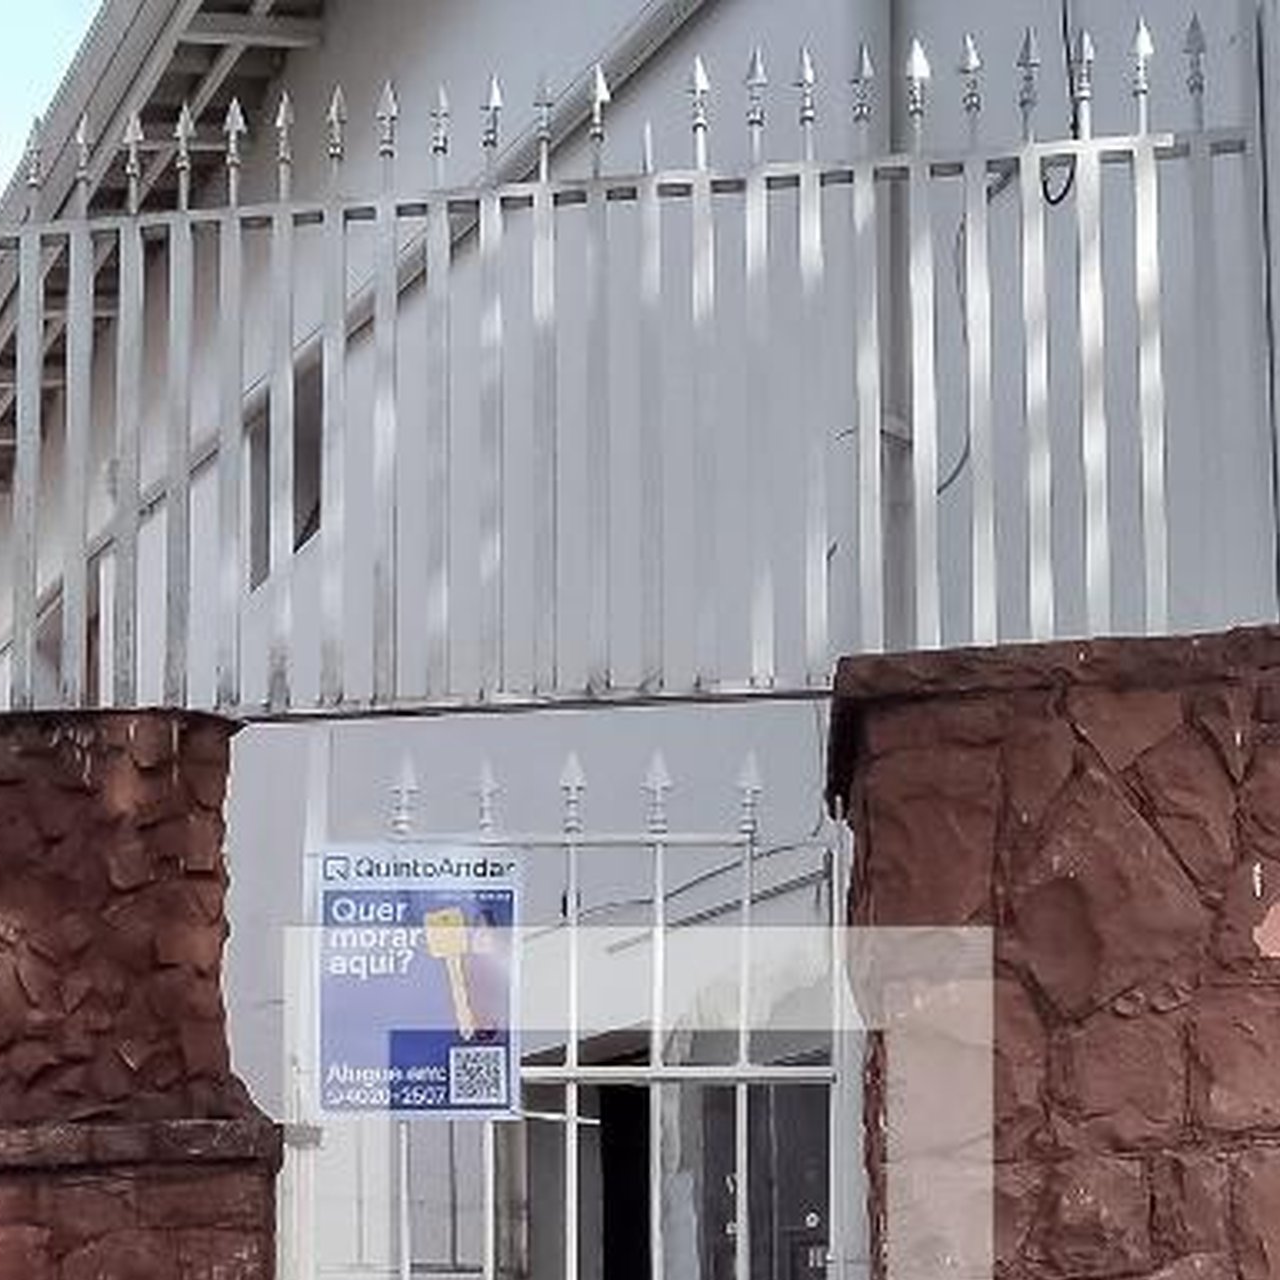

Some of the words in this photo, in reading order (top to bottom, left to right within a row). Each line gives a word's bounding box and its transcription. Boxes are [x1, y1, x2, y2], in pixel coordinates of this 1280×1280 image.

[355, 858, 516, 878] QuintoAndar
[331, 898, 408, 922] Quer
[331, 926, 423, 948] morar
[329, 949, 414, 980] aqui?
